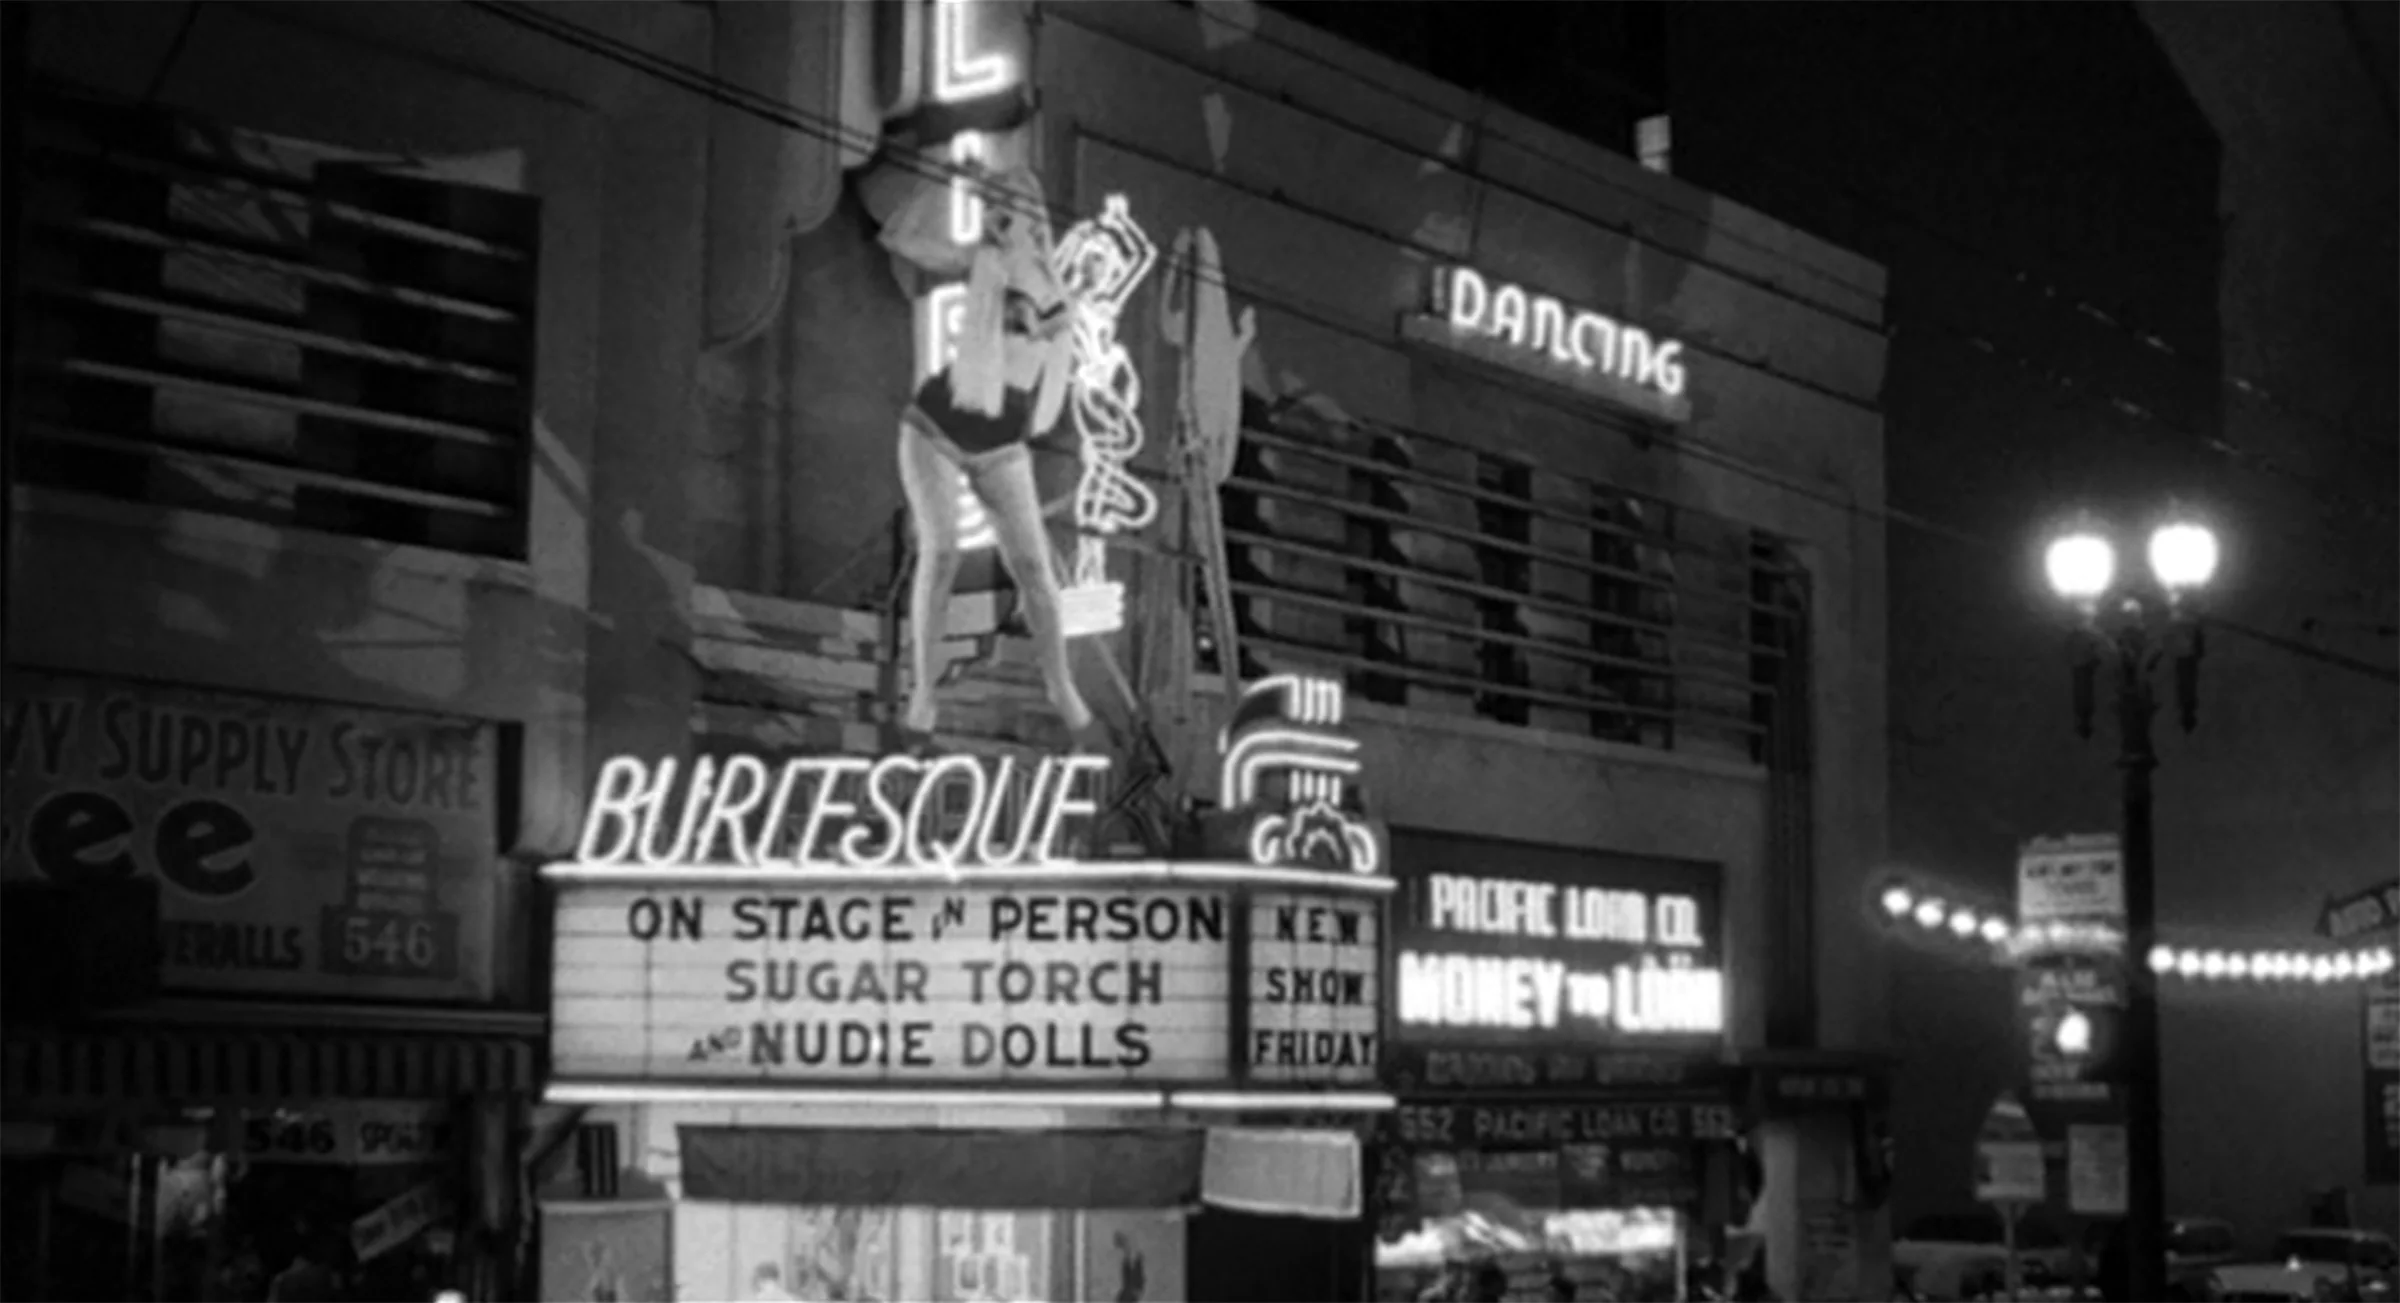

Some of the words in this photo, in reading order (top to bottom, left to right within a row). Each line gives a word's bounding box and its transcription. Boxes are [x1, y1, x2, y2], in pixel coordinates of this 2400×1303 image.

[1451, 267, 1686, 395] DANCING
[100, 700, 308, 797] SUPPLY
[328, 718, 482, 810] STORE
[577, 753, 1110, 878] BURLESQUE
[0, 790, 256, 898] ee
[627, 897, 703, 942] ON
[730, 897, 914, 942] STAGE
[932, 897, 965, 942] IN
[990, 896, 1223, 942] PERSON
[1275, 905, 1361, 944] NEW
[1428, 873, 1557, 937] PACIFIC
[1563, 886, 1648, 942] LOAN
[342, 914, 436, 967] 546
[725, 959, 930, 1004] SUGAR
[962, 961, 1162, 1005] TORCH
[1266, 967, 1365, 1006] SHOW
[1398, 949, 1566, 1029] MONEY
[1612, 962, 1724, 1033] LOAN
[749, 1021, 934, 1067] NUDIE
[962, 1022, 1152, 1068] DOLLS
[1254, 1029, 1378, 1068] FRIDAY
[243, 1118, 335, 1155] 546
